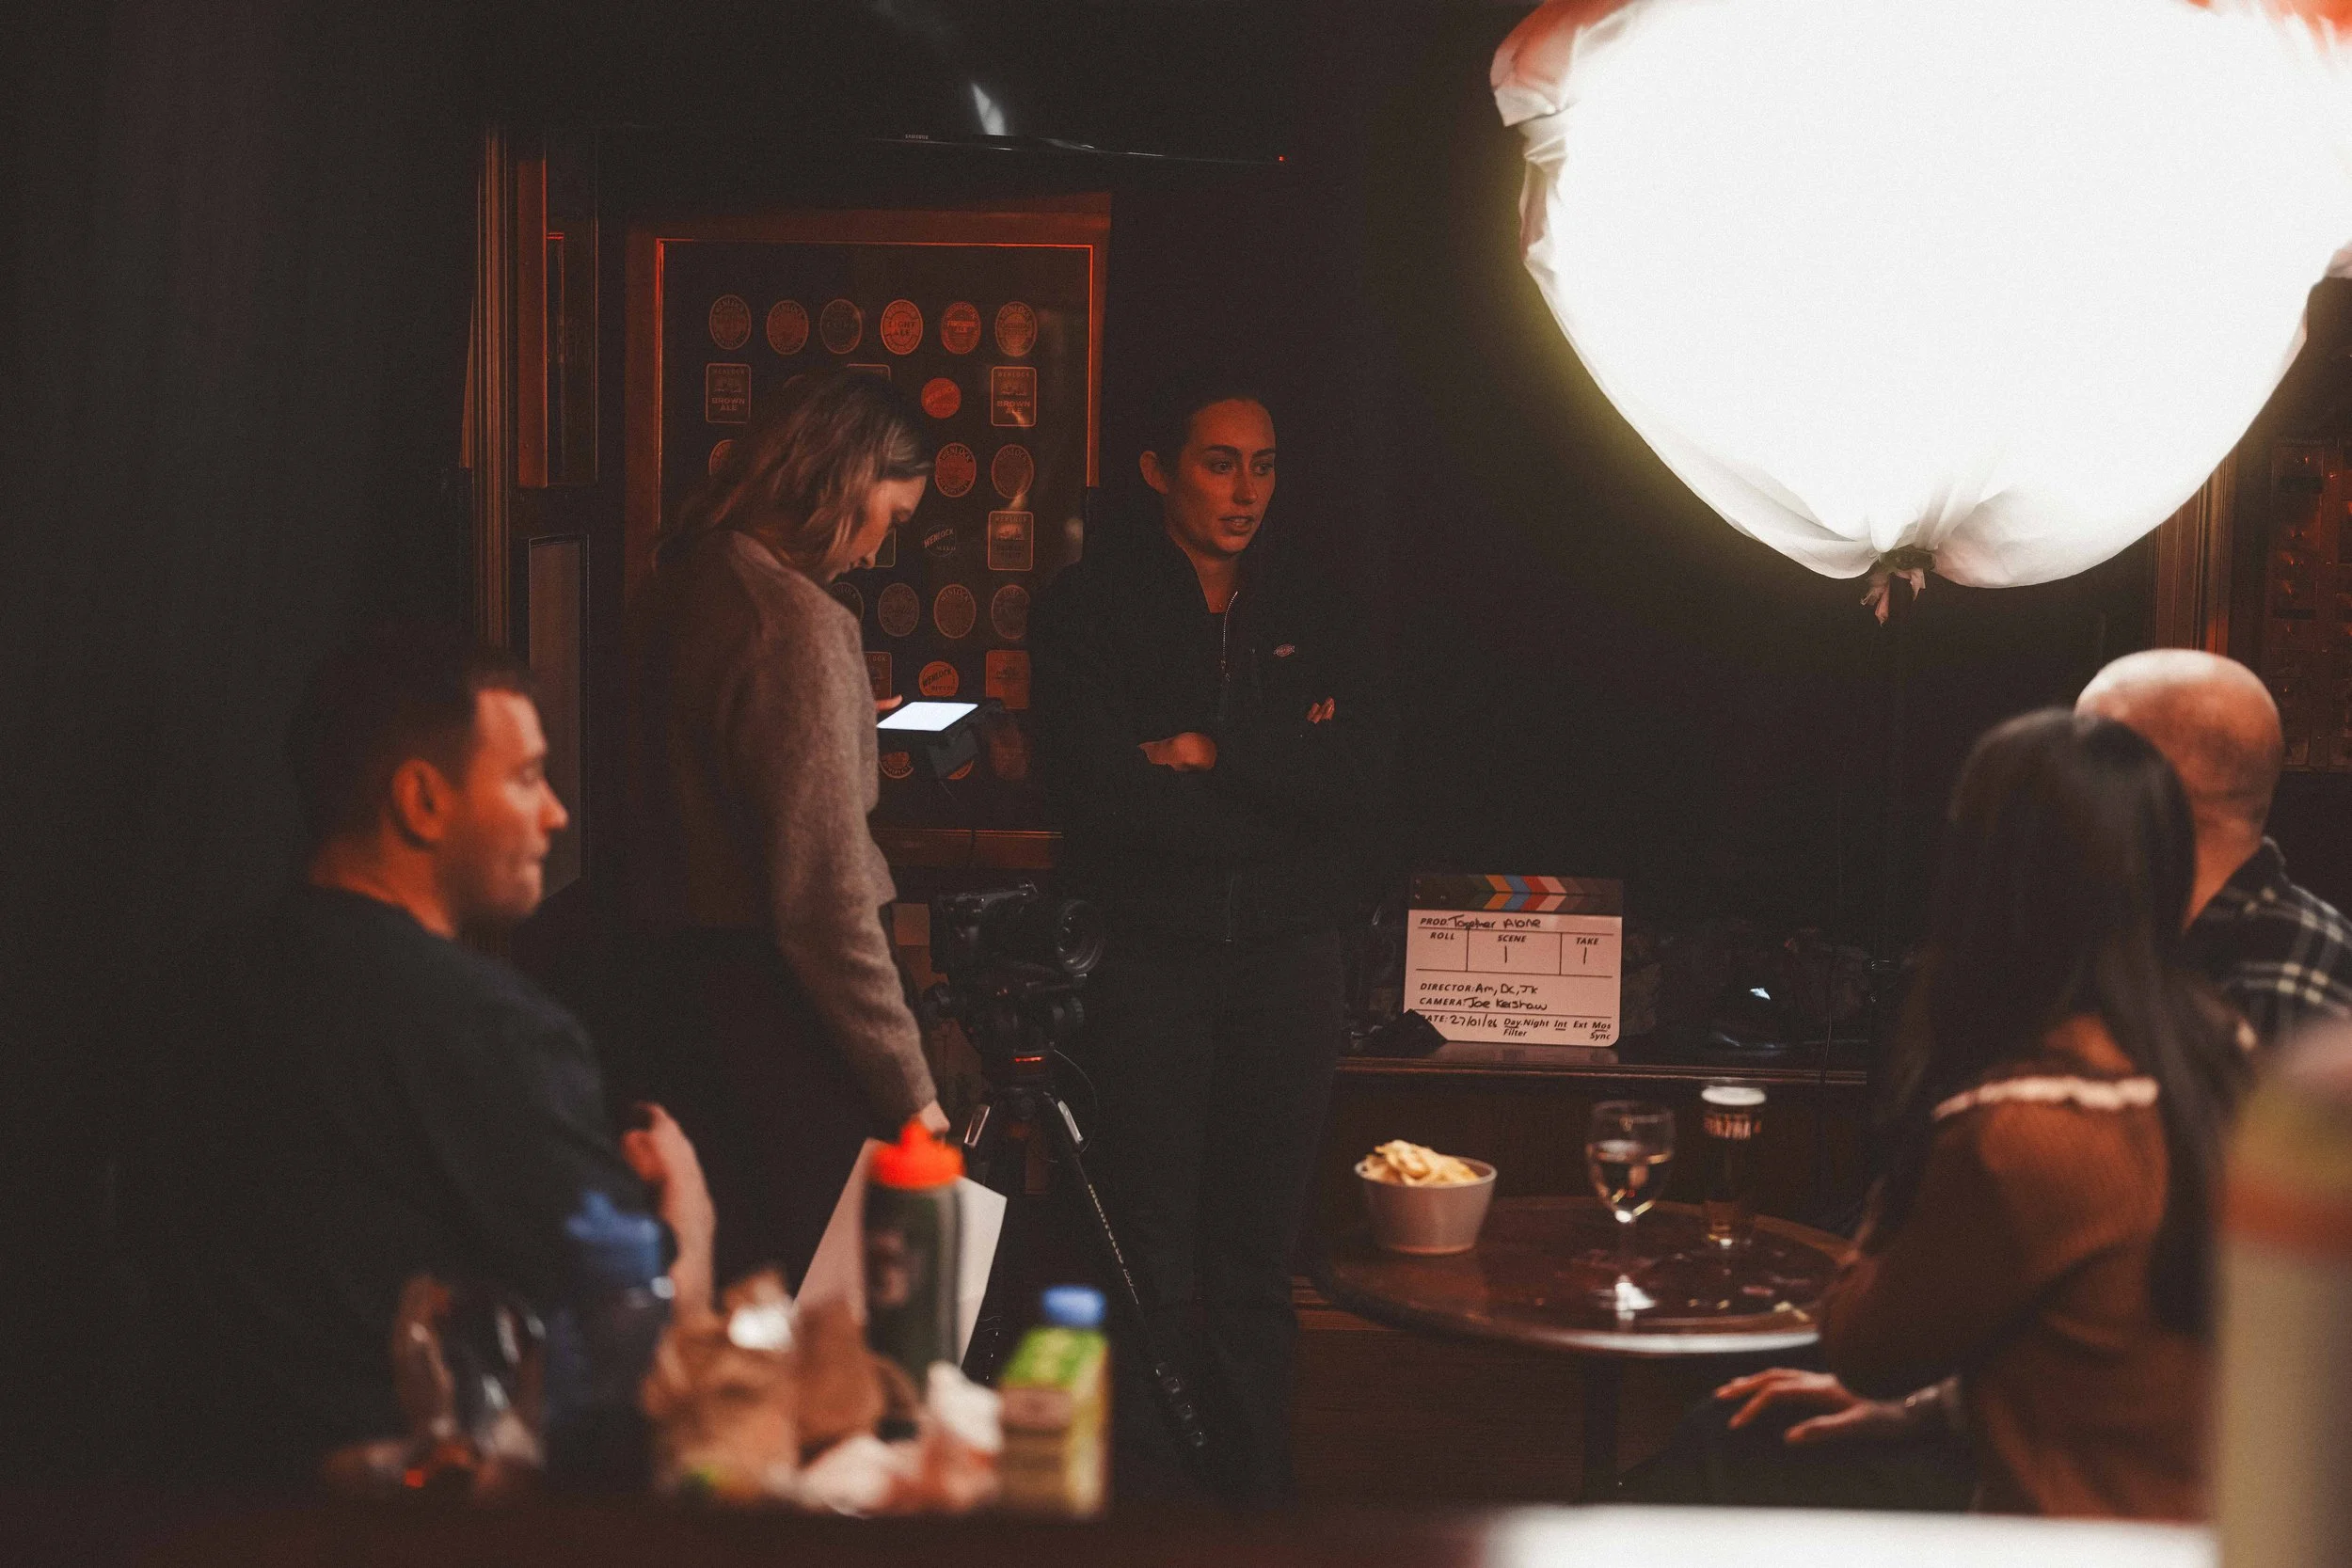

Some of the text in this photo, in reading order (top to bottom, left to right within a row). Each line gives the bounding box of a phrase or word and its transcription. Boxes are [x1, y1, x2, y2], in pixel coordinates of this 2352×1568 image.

[922, 528, 955, 548] WENLOCK
[923, 669, 952, 687] WENLOCK
[1448, 914, 1496, 930] Together
[1576, 937, 1599, 945] TAKE
[1420, 983, 1474, 992] DIRECTOR:
[1420, 997, 1466, 1006] CAMERA:
[1464, 996, 1490, 1008] Joe
[1554, 1019, 1567, 1027] Int
[1573, 1021, 1588, 1029] Ext
[1592, 1022, 1611, 1030] Mos
[1503, 1028, 1527, 1037] Filter
[1589, 1031, 1611, 1041] Sync
